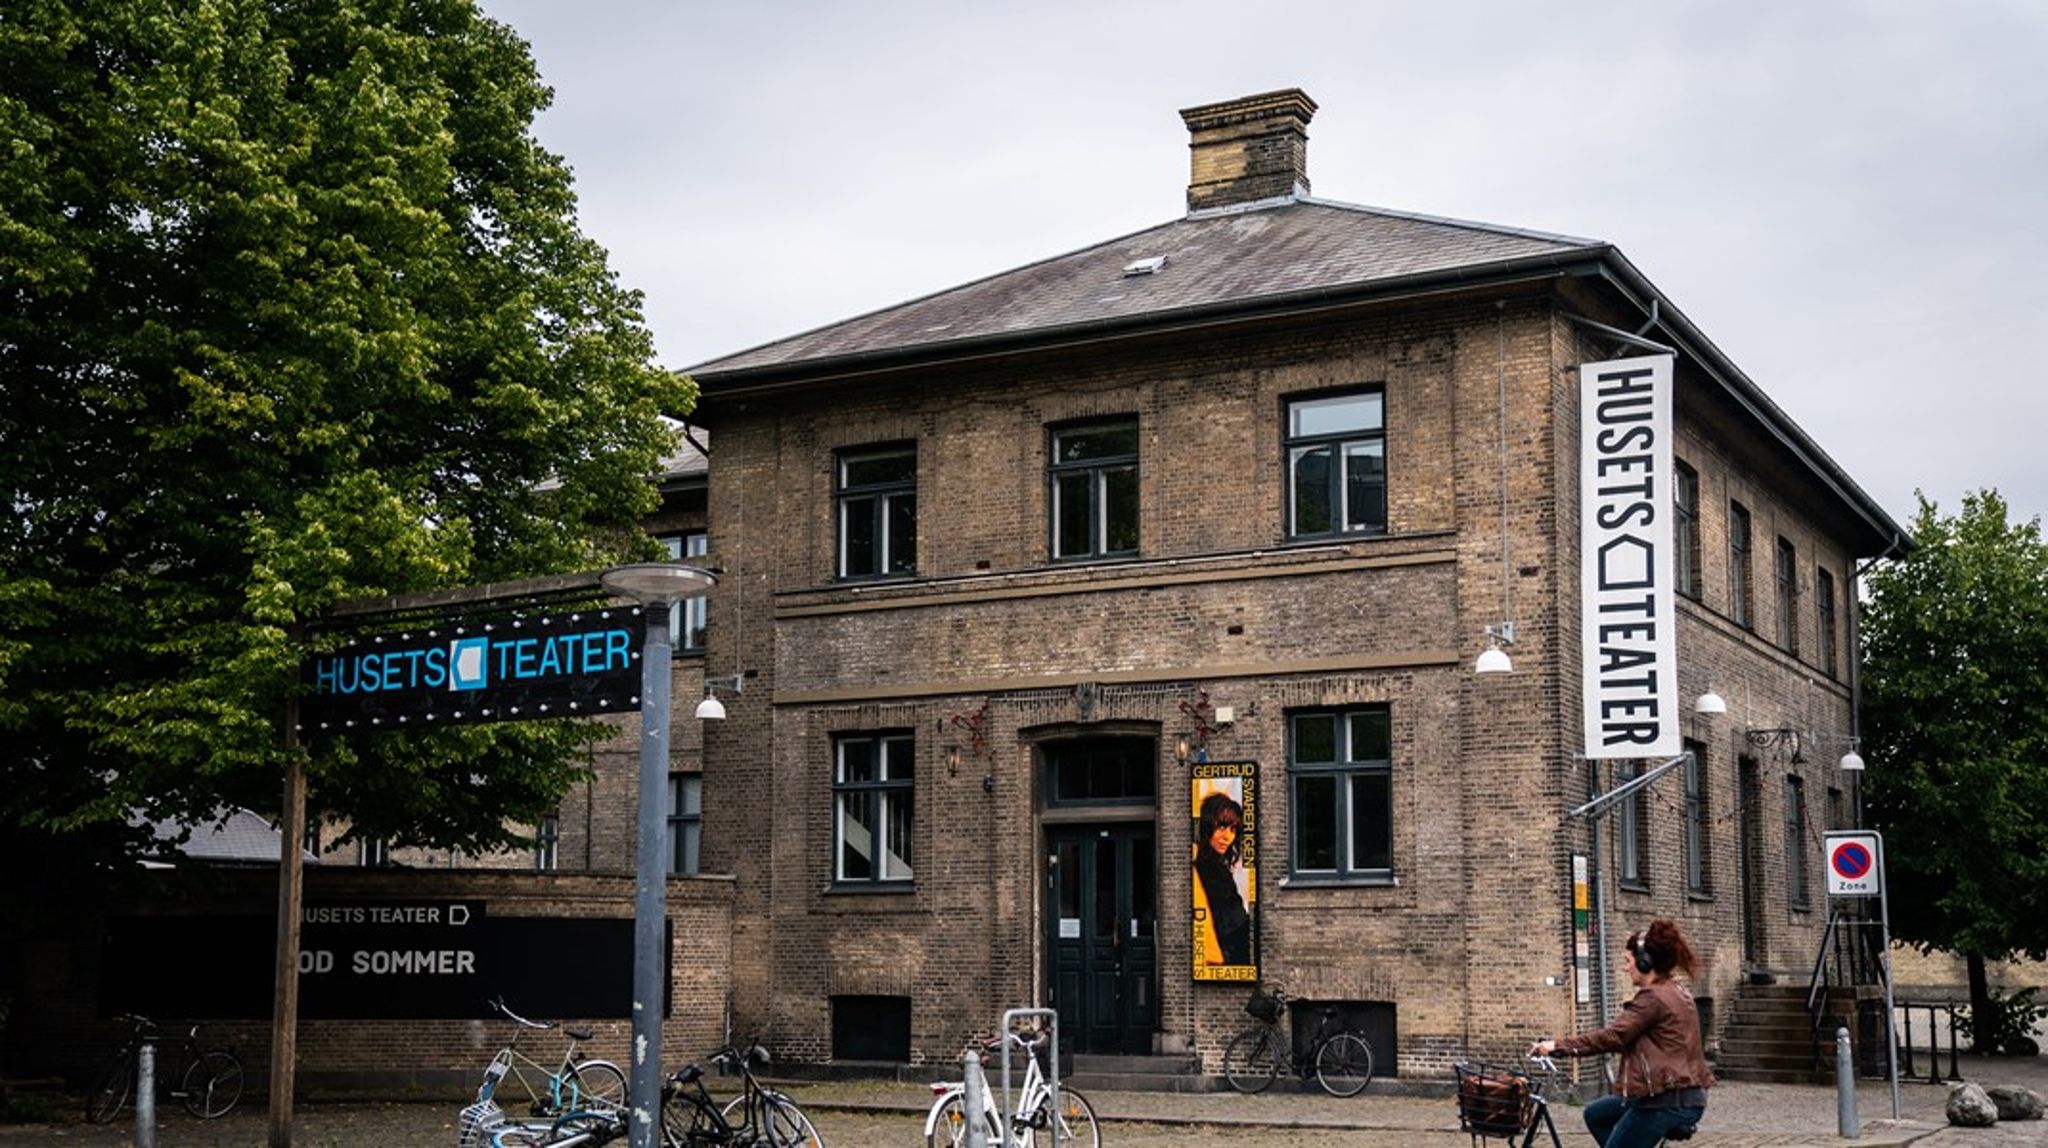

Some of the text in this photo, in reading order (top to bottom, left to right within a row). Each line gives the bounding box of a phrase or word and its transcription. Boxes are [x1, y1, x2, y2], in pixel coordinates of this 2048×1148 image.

[1596, 367, 1660, 747] HUSETS TEATER
[317, 628, 630, 695] HUSETS TEATER
[1193, 763, 1255, 778] GERTRUD
[1243, 777, 1255, 832] SVARER
[1243, 833, 1256, 868] IGEN
[1839, 881, 1867, 891] Zone
[368, 906, 440, 924] TEATER
[351, 949, 476, 975] SOMMER
[1208, 967, 1256, 979] TEATER
